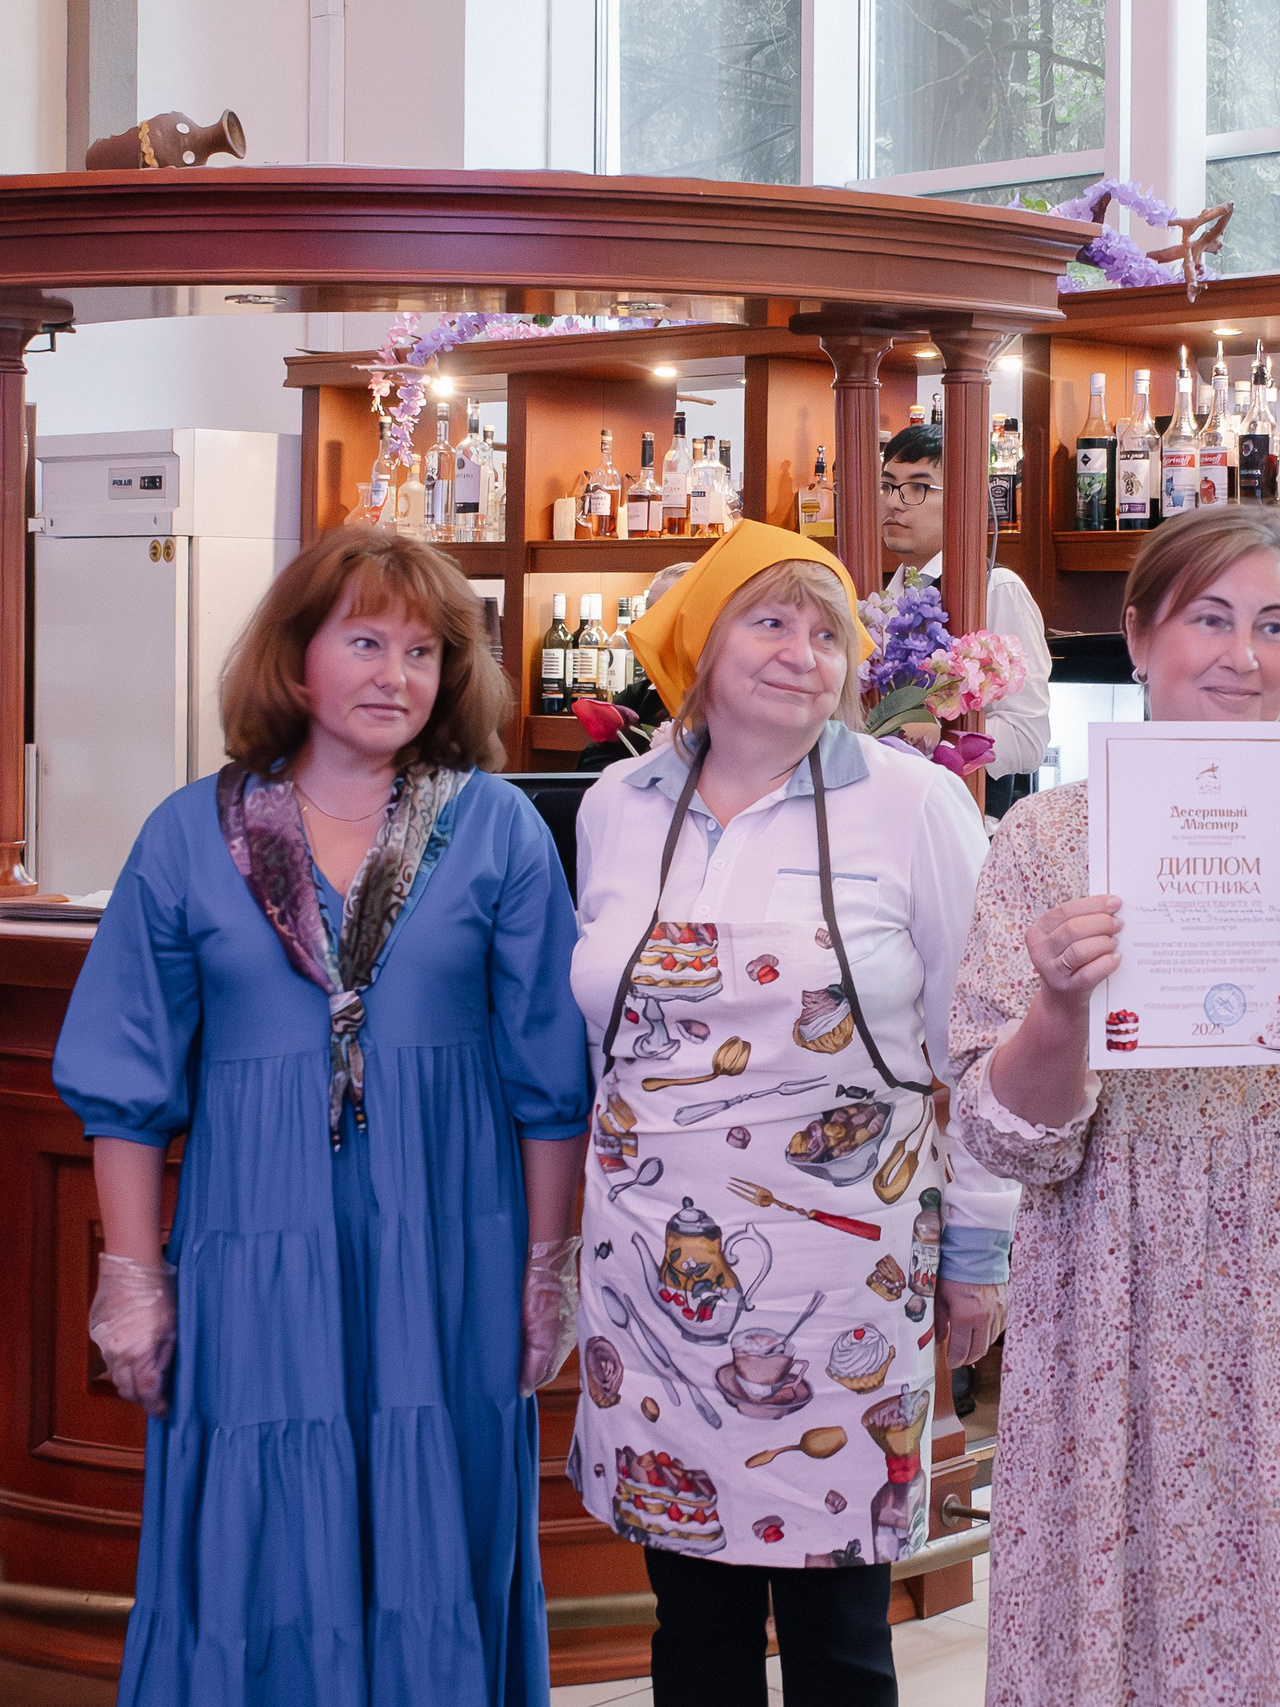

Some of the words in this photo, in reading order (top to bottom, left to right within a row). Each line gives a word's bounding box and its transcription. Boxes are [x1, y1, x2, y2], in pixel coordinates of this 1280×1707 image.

[1170, 805, 1247, 820] Десертный
[1181, 818, 1239, 832] Мастер
[1157, 856, 1261, 879] ДИПЛОМ
[1158, 880, 1261, 895] УЧАСТНИКА
[1191, 1022, 1225, 1037] 2025
